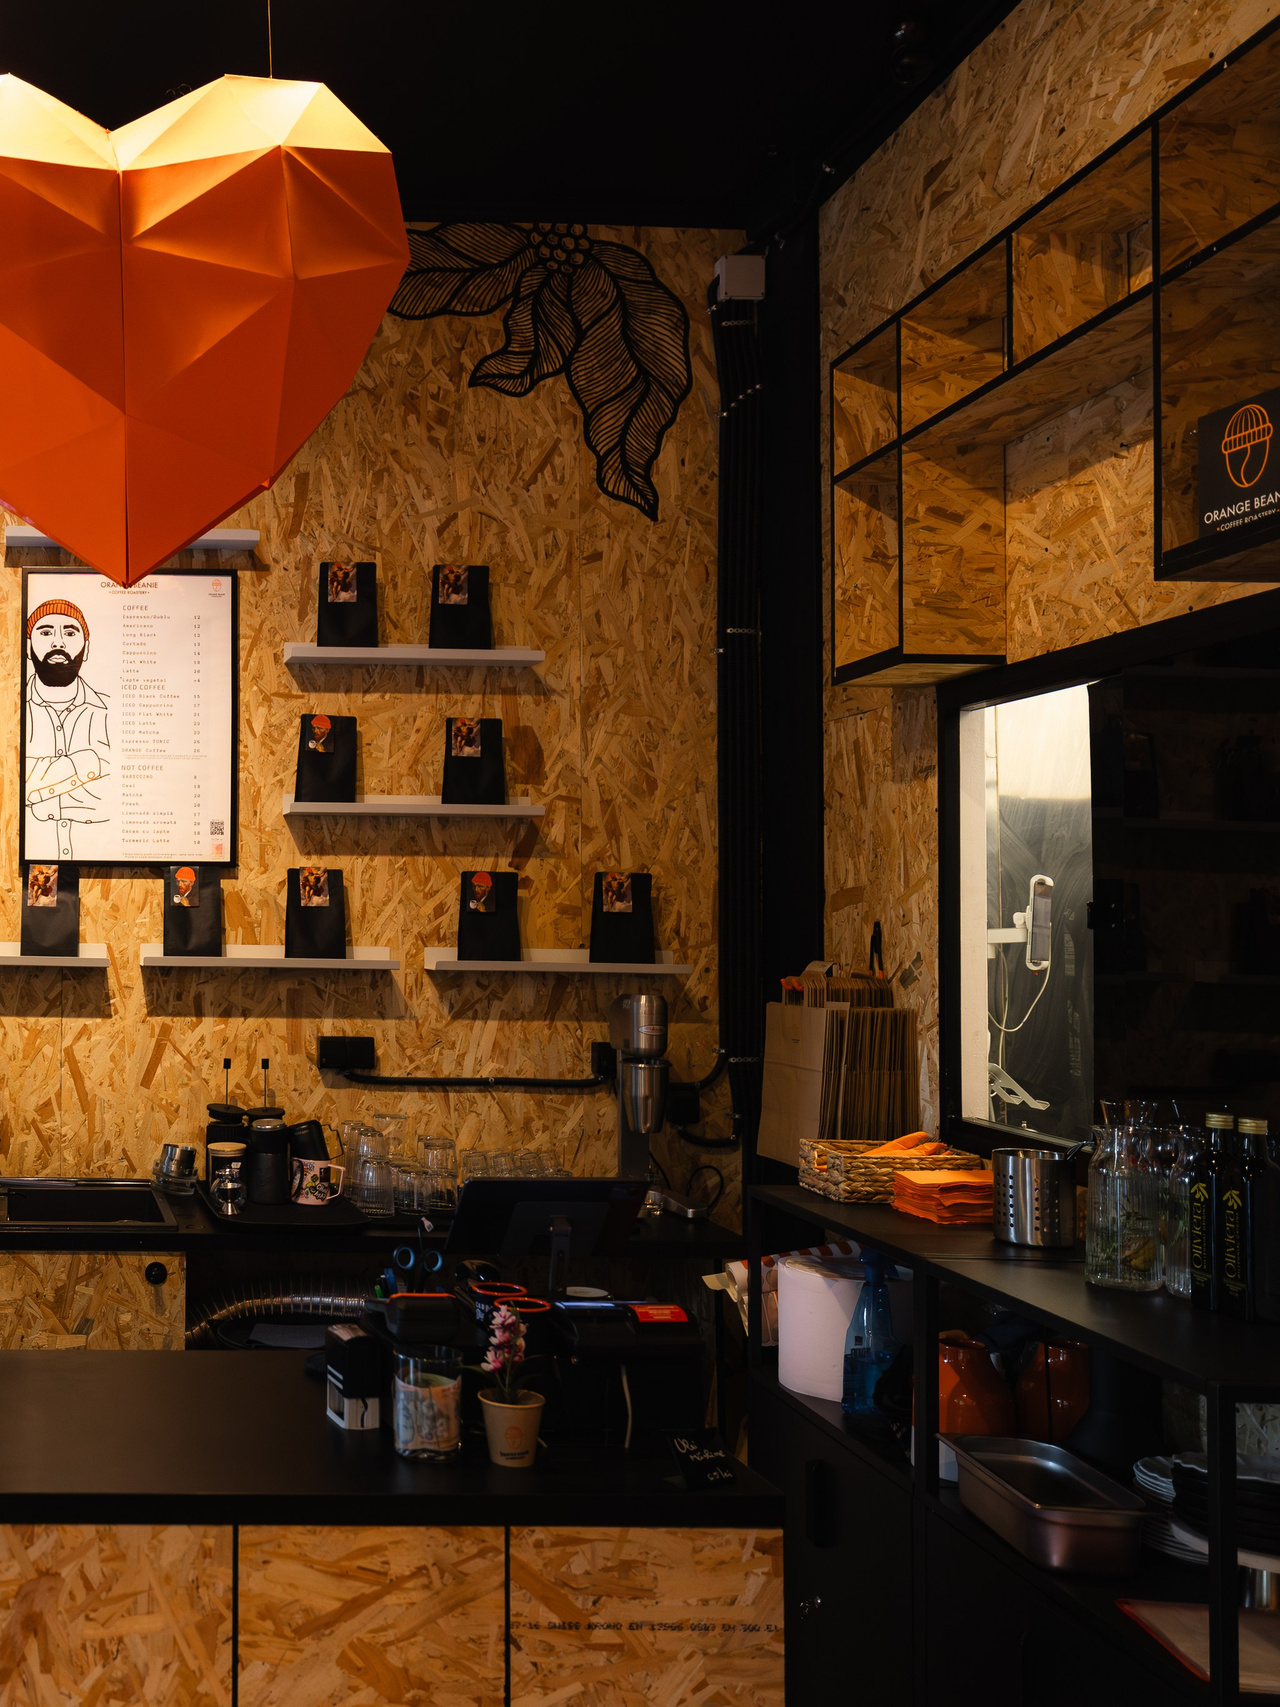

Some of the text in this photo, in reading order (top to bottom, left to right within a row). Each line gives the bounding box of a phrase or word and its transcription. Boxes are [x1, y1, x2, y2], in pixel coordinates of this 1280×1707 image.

[1203, 499, 1251, 524] ORANGE
[1220, 508, 1276, 532] COFFEE ROASTERY
[1191, 1201, 1203, 1269] Oliviera
[1224, 1209, 1237, 1279] Oliviera
